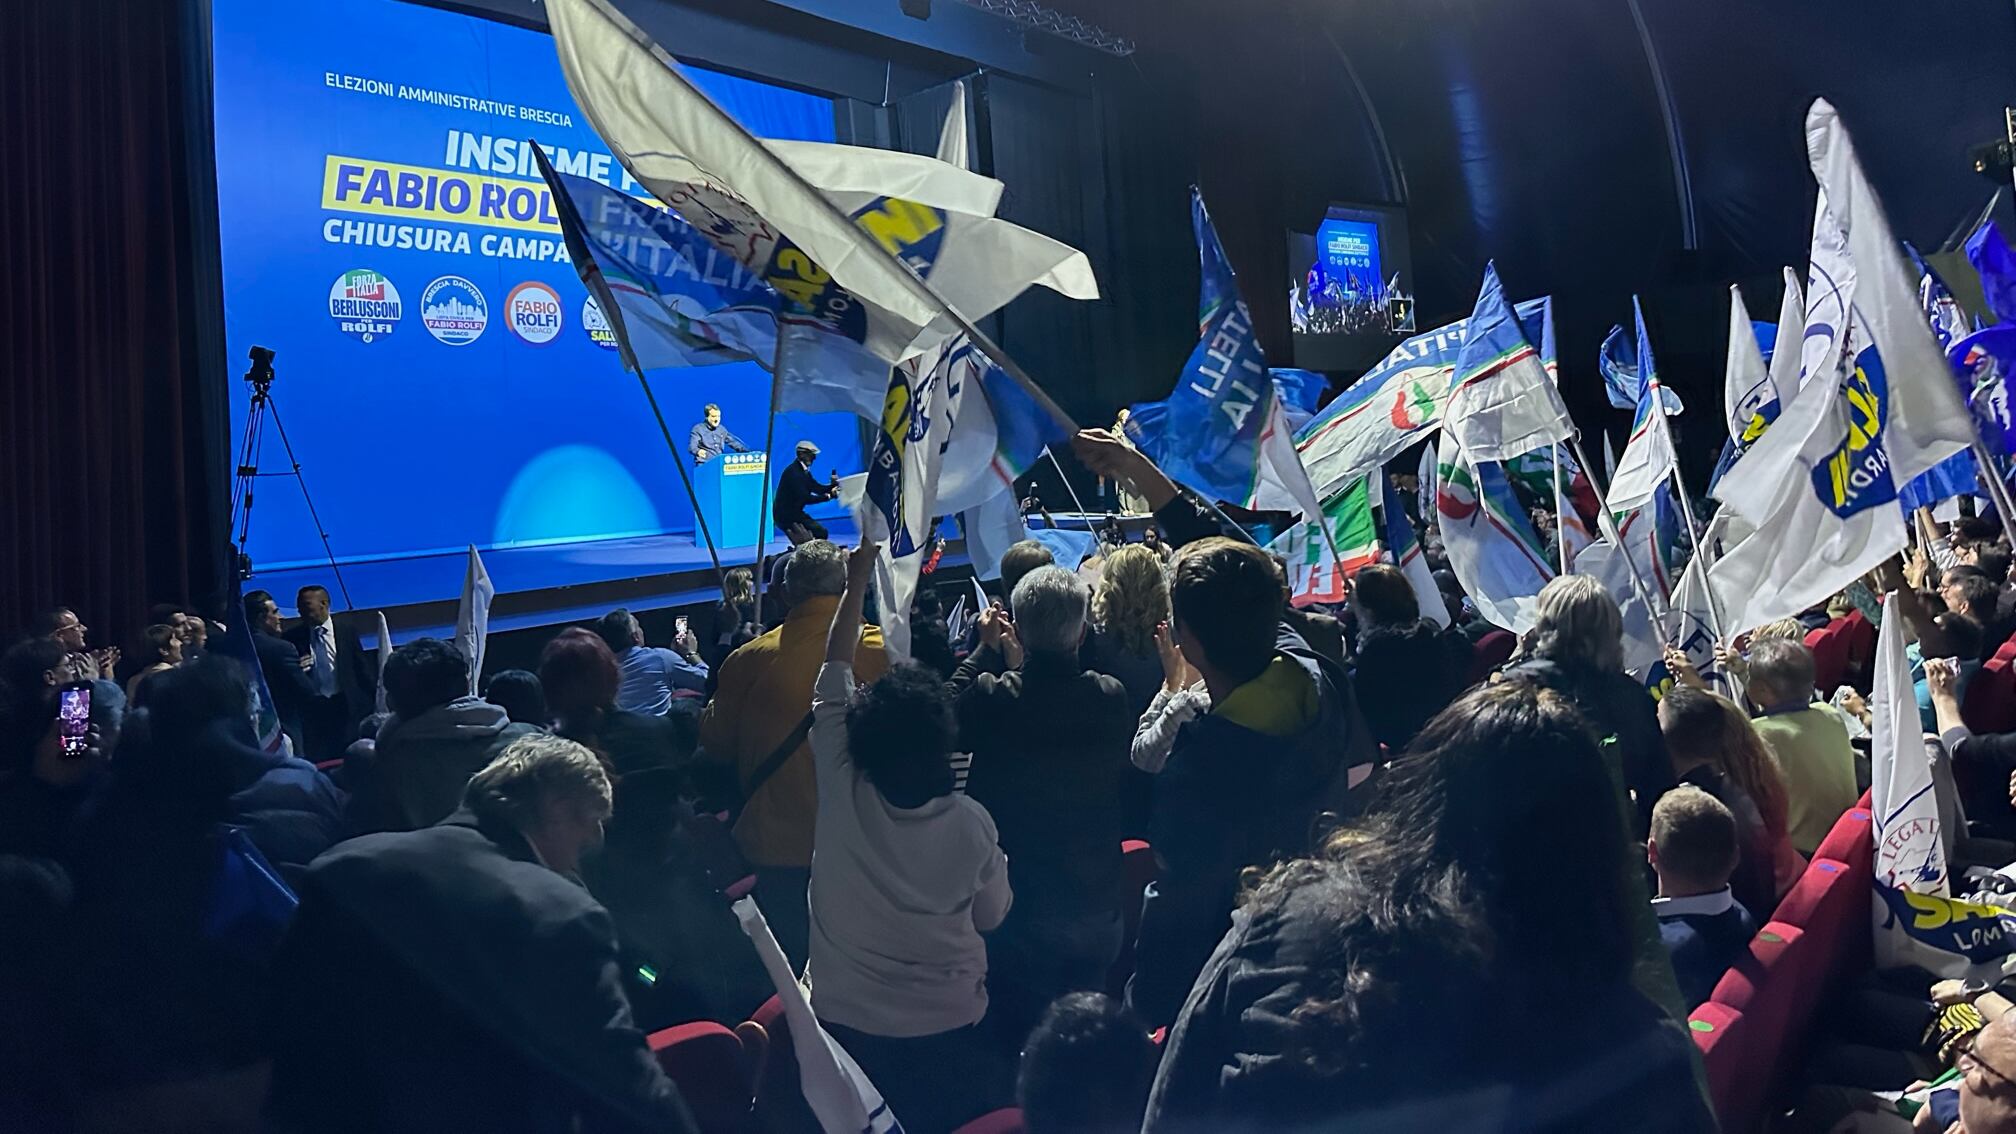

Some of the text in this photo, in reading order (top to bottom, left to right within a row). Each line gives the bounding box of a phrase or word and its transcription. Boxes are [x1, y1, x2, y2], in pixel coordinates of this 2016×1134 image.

[325, 72, 573, 128] ELEZIONI AMMINISTRATIVE BRESCIA
[335, 163, 560, 226] FABIO ROL
[323, 218, 571, 264] CHIUSURA CAMPA
[352, 273, 377, 286] FORZA
[353, 283, 379, 297] ITALIA
[426, 279, 482, 306] BRESCIA DAVVERO
[332, 298, 399, 319] BERLUSCONI
[515, 300, 558, 315] FABIO
[341, 321, 393, 334] ROLFI
[428, 320, 483, 329] FABIO ROLFI
[516, 313, 558, 328] ROLFI
[523, 326, 553, 335] SINDACO
[1882, 820, 1924, 860] LEGA
